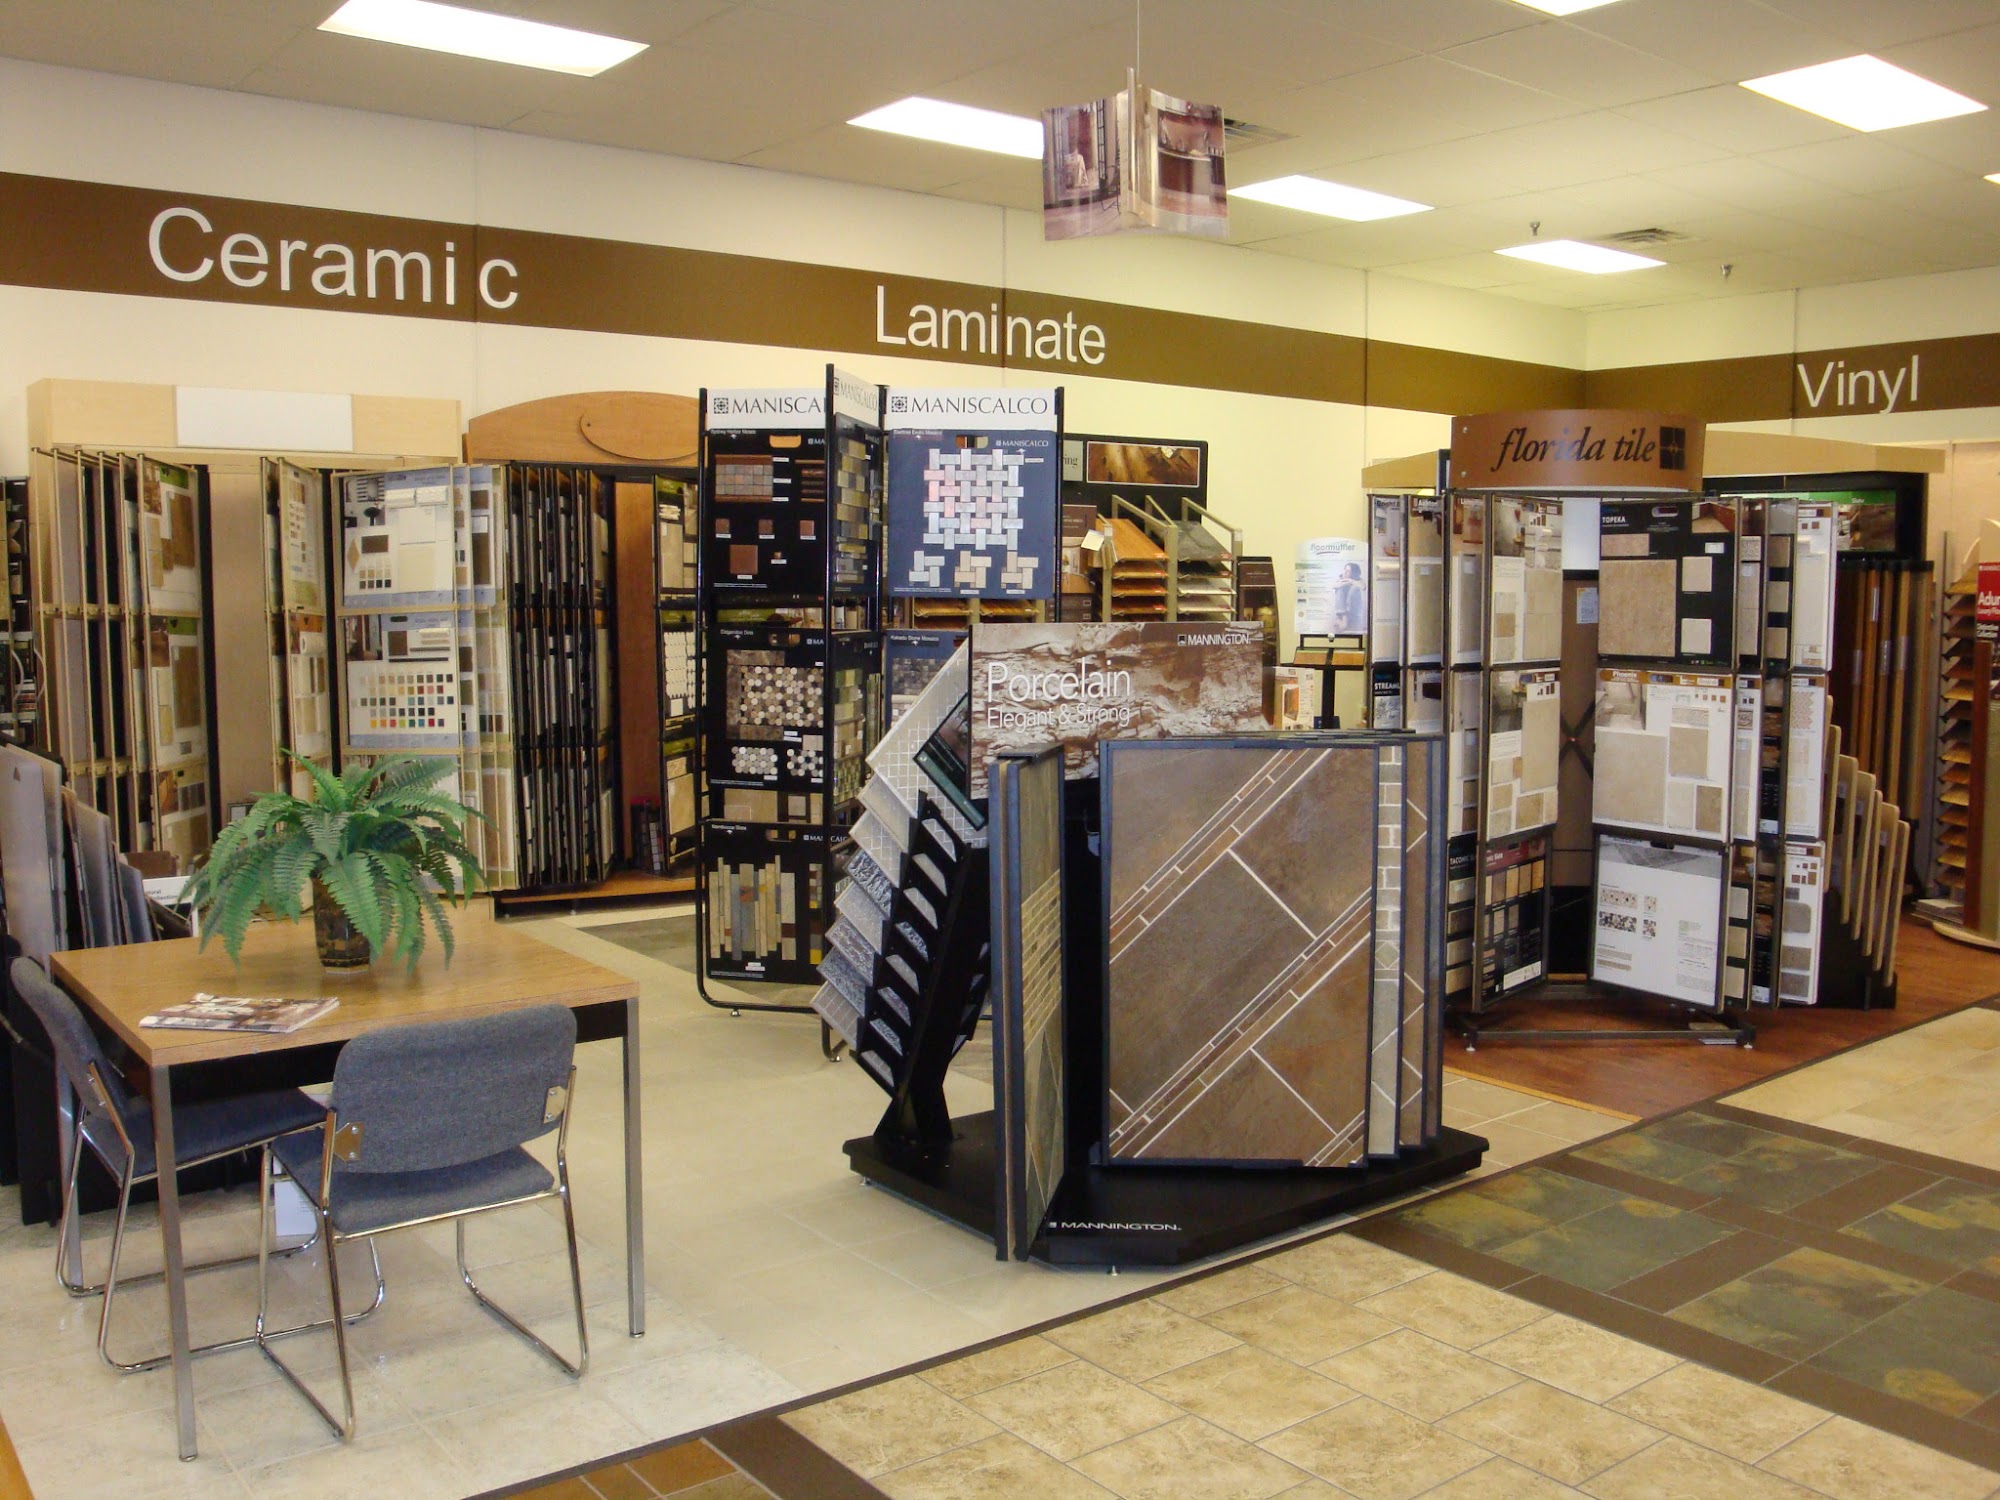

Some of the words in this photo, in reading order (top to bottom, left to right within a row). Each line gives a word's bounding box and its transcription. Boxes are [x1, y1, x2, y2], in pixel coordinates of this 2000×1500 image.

[148, 206, 519, 310] Ceramic
[876, 284, 1106, 365] Laminate
[1797, 354, 1919, 415] Vinyl
[911, 397, 1049, 414] MANISCALCO
[1003, 439, 1049, 447] MANISCALCO
[1490, 426, 1604, 472] florida
[1613, 427, 1655, 462] tile
[1602, 516, 1626, 524] TOPEKA
[986, 657, 1131, 703] Porcelain
[1612, 670, 1638, 679] Phoenix
[987, 706, 1054, 733] Elegant
[1058, 702, 1072, 725] &
[1076, 703, 1131, 728] Strong
